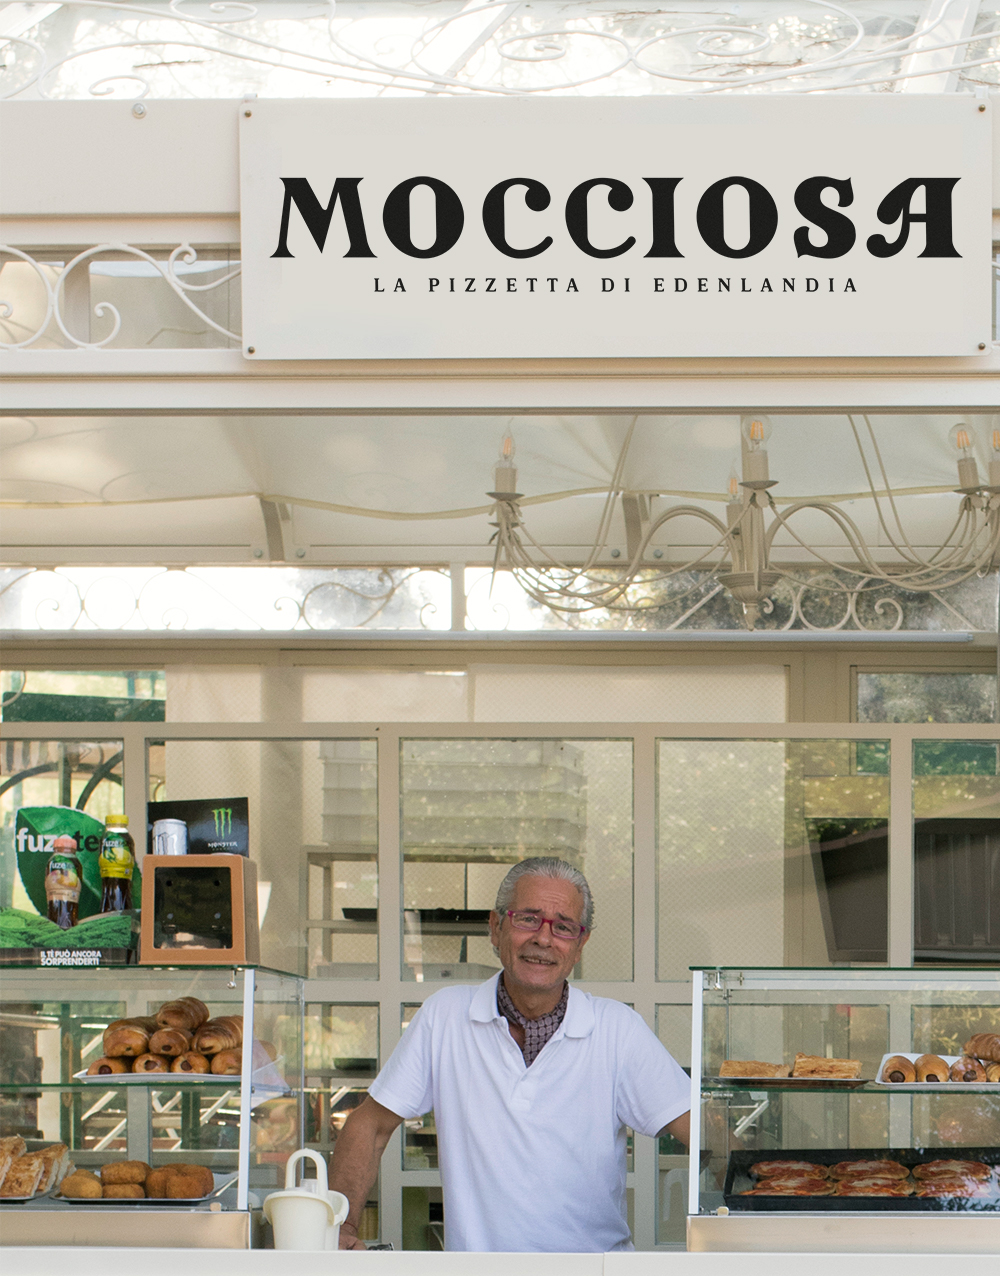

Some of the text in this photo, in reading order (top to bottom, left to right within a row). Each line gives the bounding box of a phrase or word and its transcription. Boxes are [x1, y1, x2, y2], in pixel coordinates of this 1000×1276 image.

[270, 175, 963, 259] MOCCIOSA
[373, 277, 857, 293] LA PIZZETTA DI EDENLANDIA
[71, 950, 102, 958] ANCORA
[40, 958, 100, 966] SORPRENDERTI
